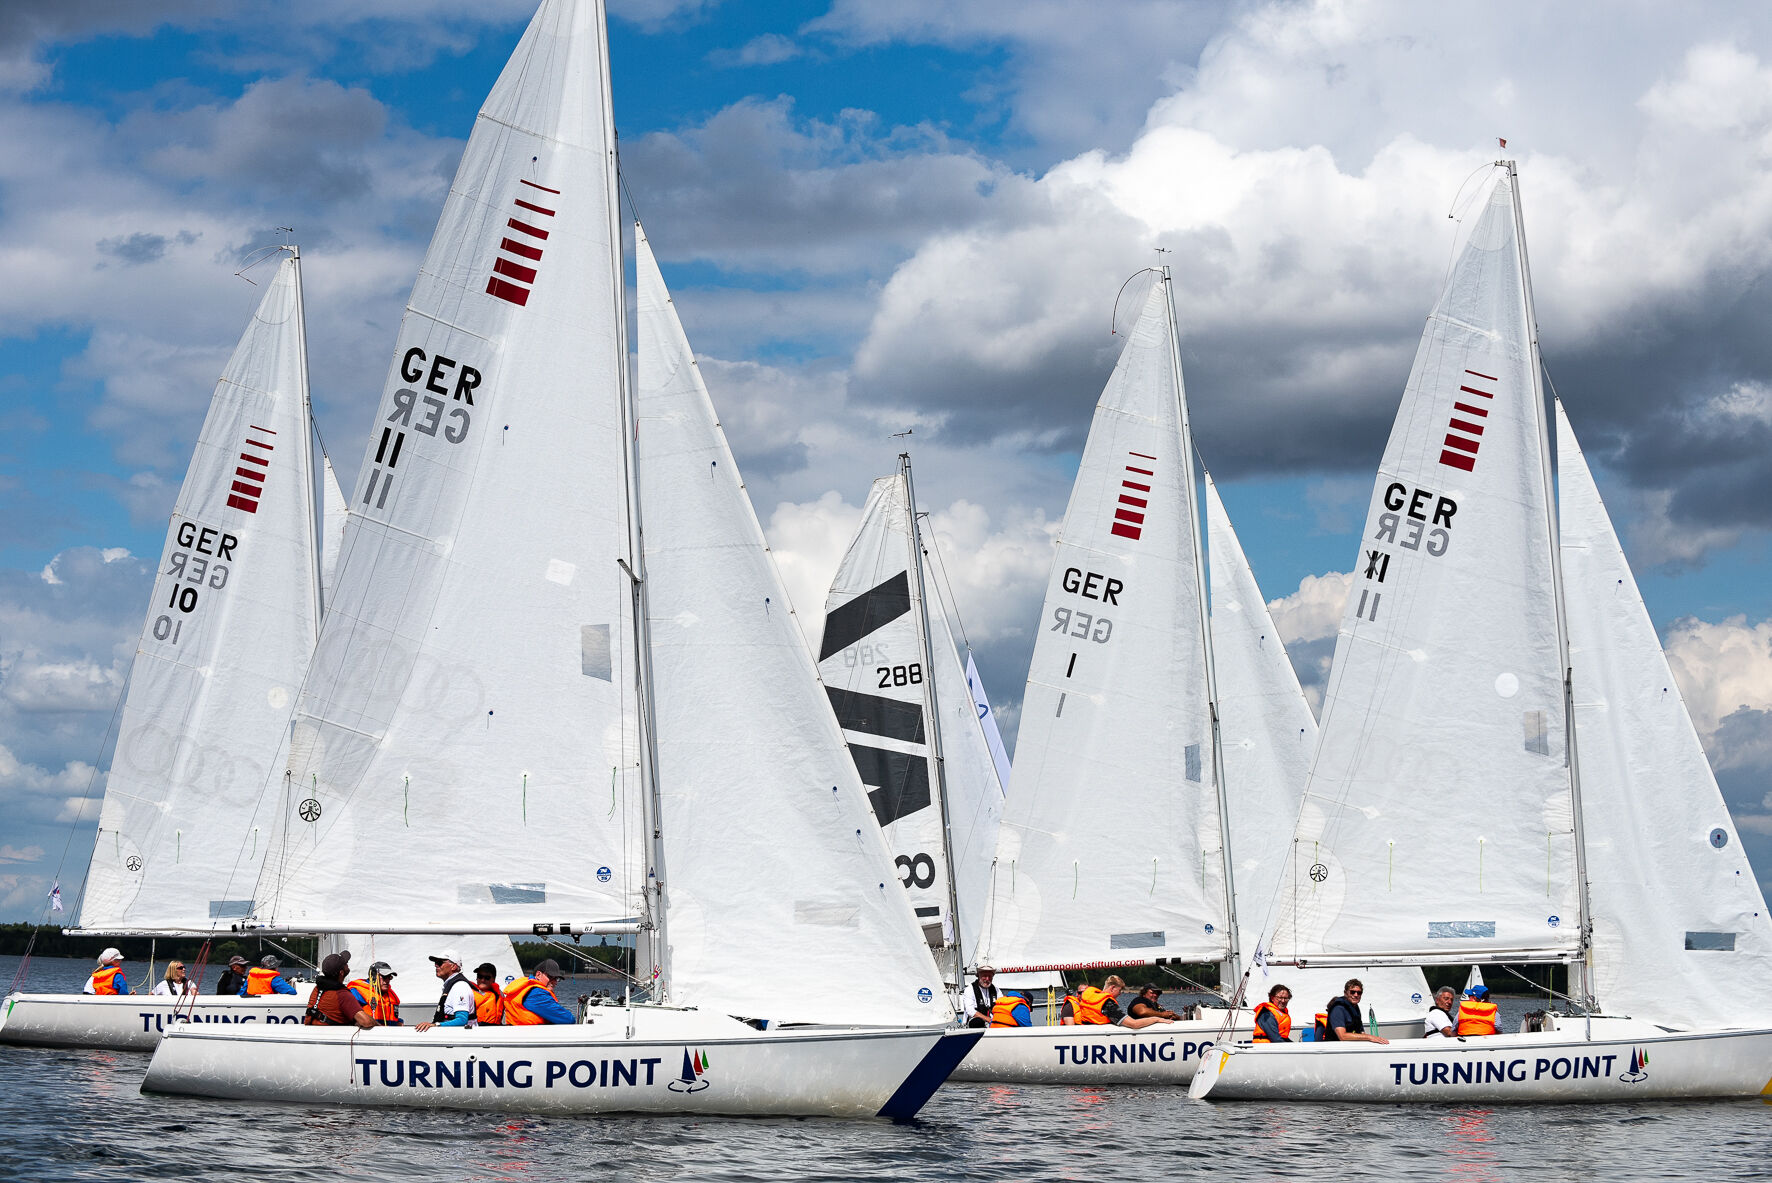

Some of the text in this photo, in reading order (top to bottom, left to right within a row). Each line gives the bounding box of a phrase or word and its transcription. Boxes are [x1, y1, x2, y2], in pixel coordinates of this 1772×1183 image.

[401, 347, 482, 406] GER
[374, 427, 406, 469] 11
[1384, 482, 1458, 530] GER
[177, 522, 238, 562] GER
[169, 583, 198, 613] 10
[1062, 567, 1124, 607] GER
[876, 662, 924, 689] 288
[1001, 958, 1146, 973] www.turningpoint-stiftung.com
[1054, 1042, 1176, 1066] TURNING
[355, 1057, 662, 1089] TURNING POINT
[1389, 1055, 1617, 1086] TURNING POINT
